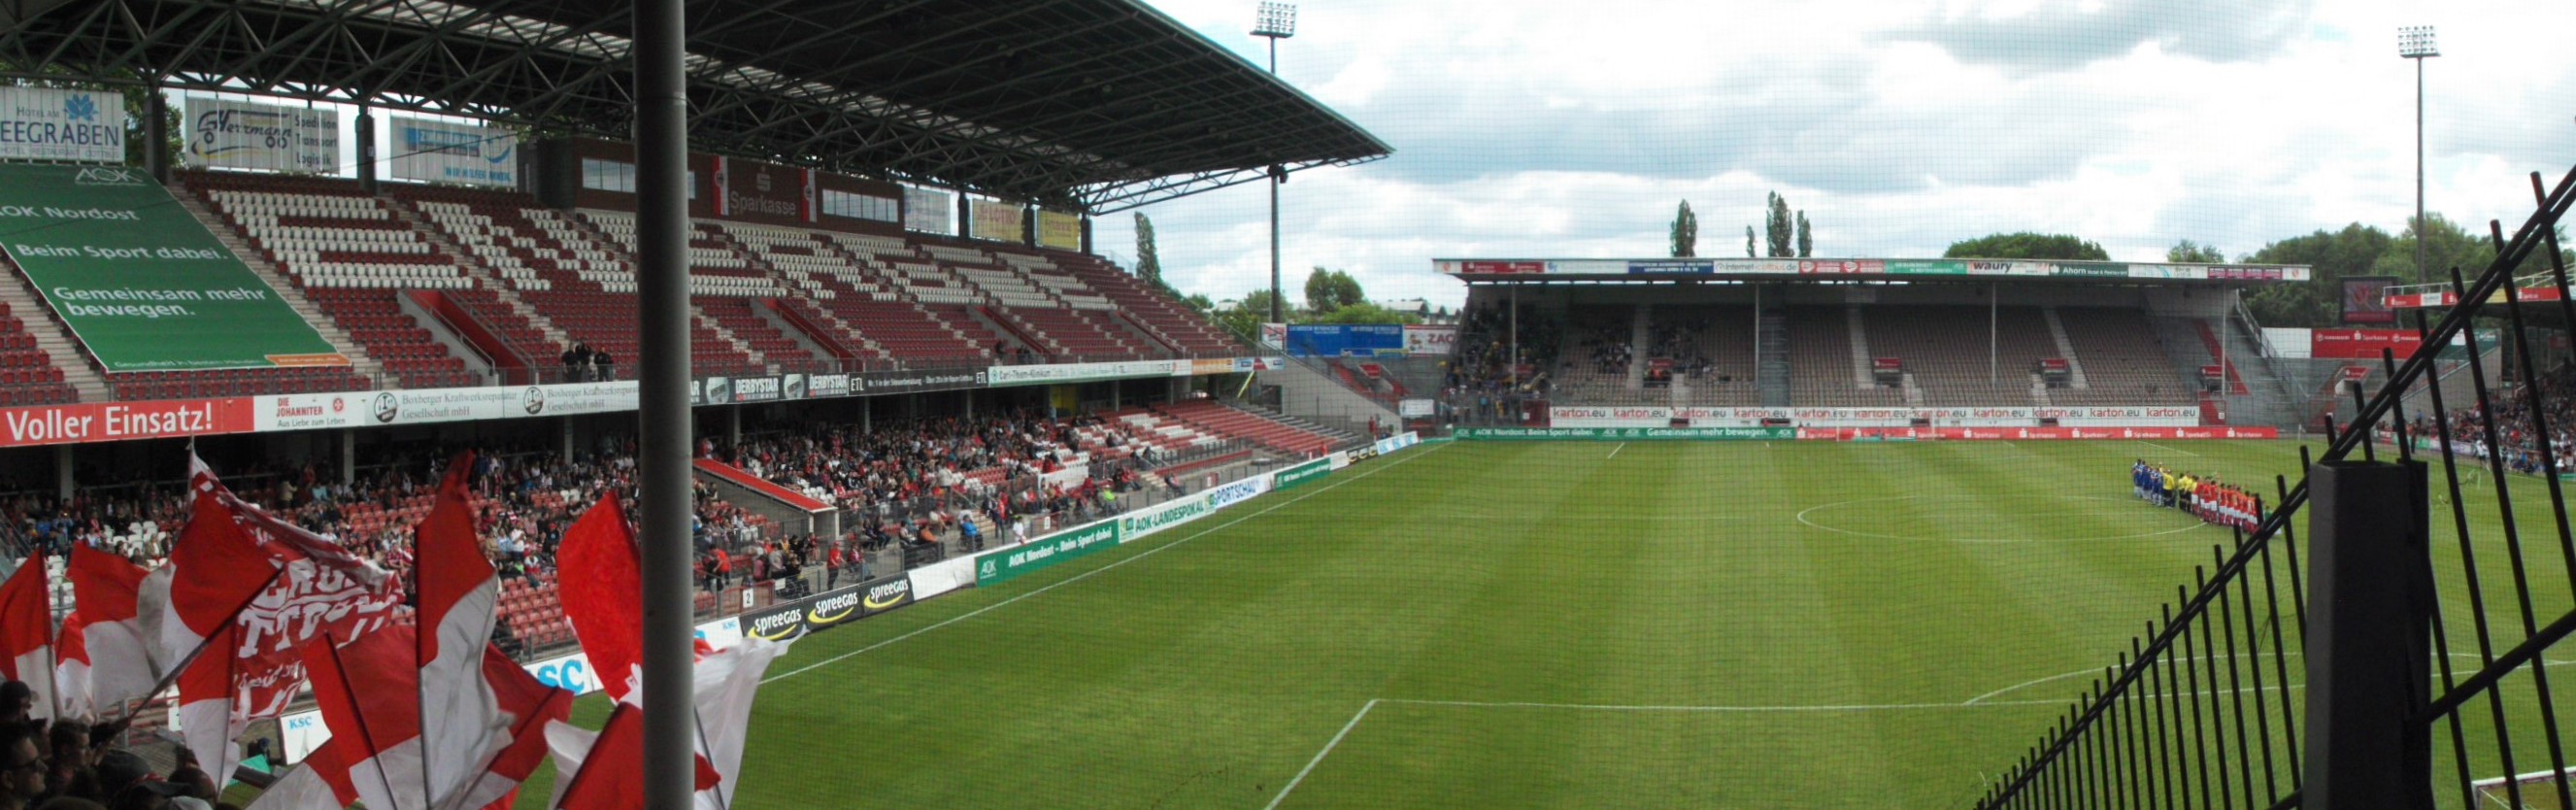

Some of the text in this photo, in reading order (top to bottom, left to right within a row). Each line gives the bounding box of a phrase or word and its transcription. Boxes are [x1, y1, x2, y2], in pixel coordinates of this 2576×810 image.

[295, 115, 337, 129] Spedition
[295, 134, 337, 147] Transport
[296, 154, 331, 167] Logistik
[75, 167, 145, 183] AOK
[730, 190, 797, 217] Sparkasse
[0, 205, 140, 221] OK Nordost
[15, 243, 228, 261] Beim Sport dabei.
[1973, 261, 2013, 273] waury
[53, 287, 267, 301] Gemeinsam mehr
[65, 302, 196, 319] bewegen.
[809, 374, 848, 389] DERBYSTAR
[976, 371, 987, 384] ETL
[735, 378, 779, 393] DERBYSTAR
[851, 378, 864, 391] ETL
[278, 397, 289, 407] DIE
[402, 394, 442, 406] Boxberger
[277, 406, 323, 418] JOHANNITER
[402, 407, 451, 420] Gesellschaft
[452, 406, 470, 417] mbH
[1614, 408, 1666, 419] karton.eu
[1674, 408, 1726, 419] karton.eu
[1734, 408, 1787, 419] karton.eu
[1974, 408, 2025, 419] karton.eu
[2032, 408, 2083, 419] karton.eu
[2091, 408, 2140, 419] karton.eu
[2147, 408, 2195, 419] karton.eu
[6, 401, 213, 441] Voller Einsatz!
[278, 420, 287, 428] Aus
[291, 418, 309, 426] Liebe
[1549, 428, 1570, 438] Sport
[1647, 427, 1698, 436] Gemeinsam
[1725, 428, 1770, 438] bewegen.
[1135, 500, 1204, 532] AOK-LANDESPOKAL
[1009, 553, 1026, 568] AOK
[1026, 544, 1054, 562] Nordost
[1078, 532, 1095, 550] Sport
[289, 716, 312, 730] KSC
